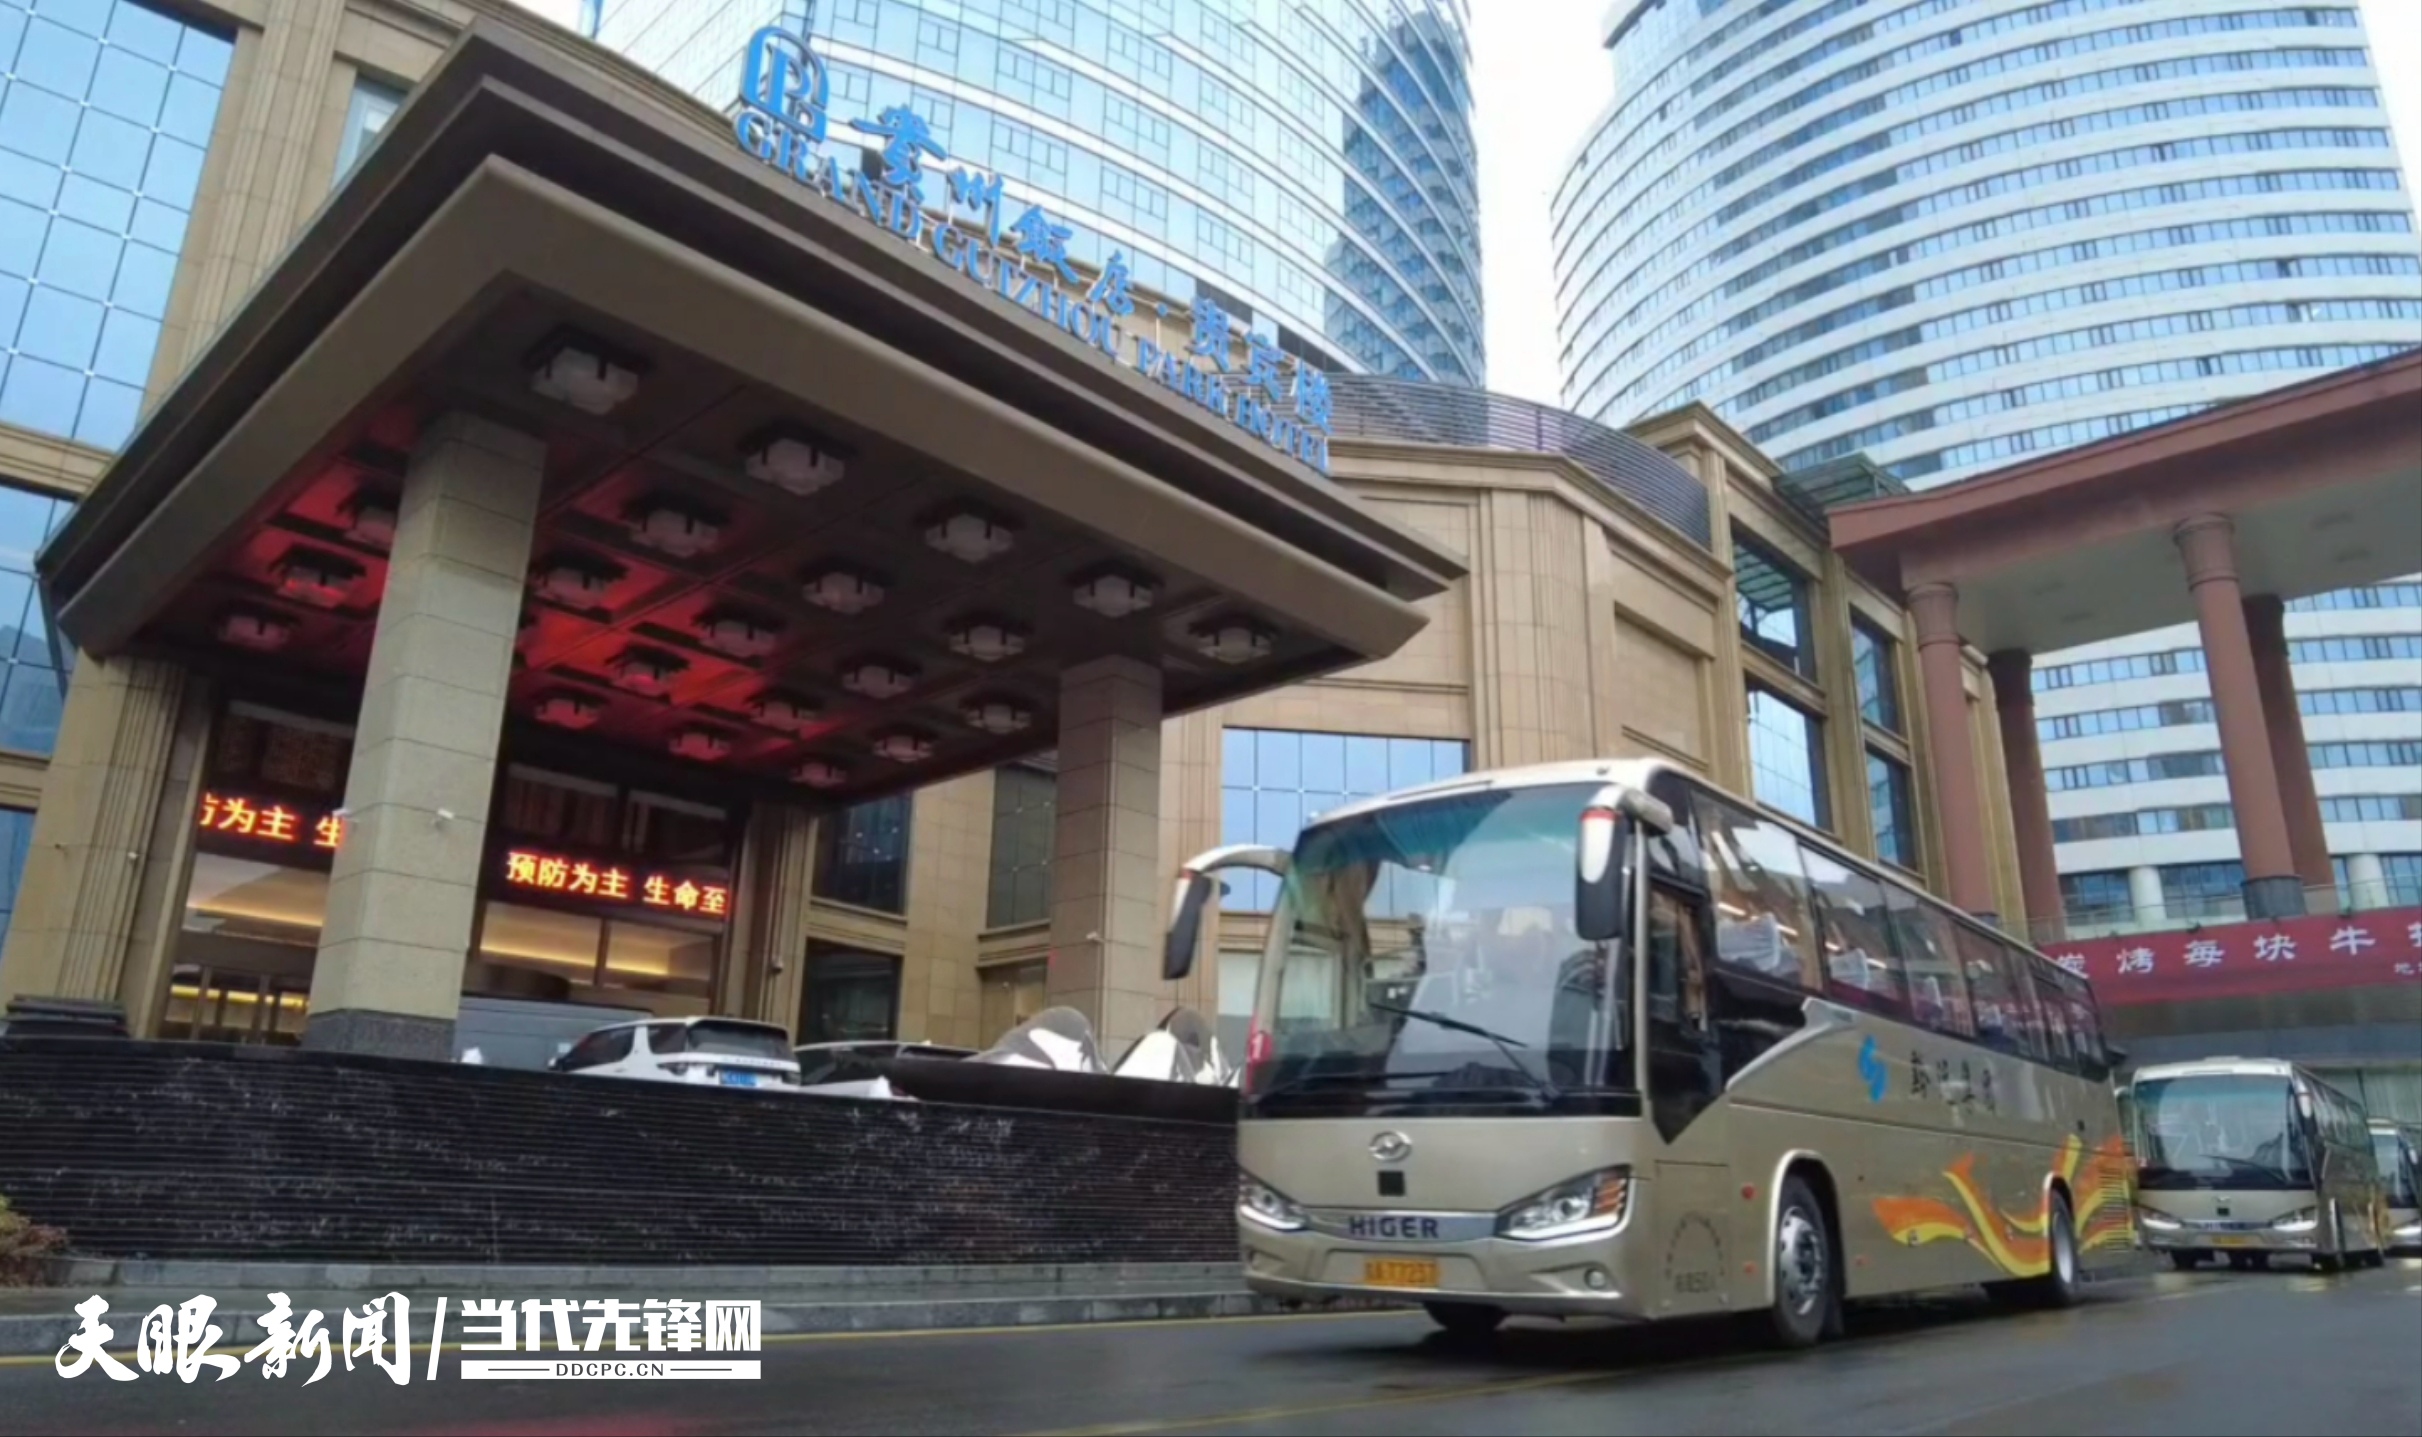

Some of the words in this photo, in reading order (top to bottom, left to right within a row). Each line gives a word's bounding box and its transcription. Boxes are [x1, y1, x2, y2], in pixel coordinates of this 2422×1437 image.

[734, 110, 922, 241] GRAND
[931, 222, 1122, 359] GUIZHOU
[1138, 336, 1229, 420] PARK
[506, 851, 630, 899] 预防为主
[643, 875, 728, 915] 生命至
[1348, 1215, 1440, 1240] HIGER
